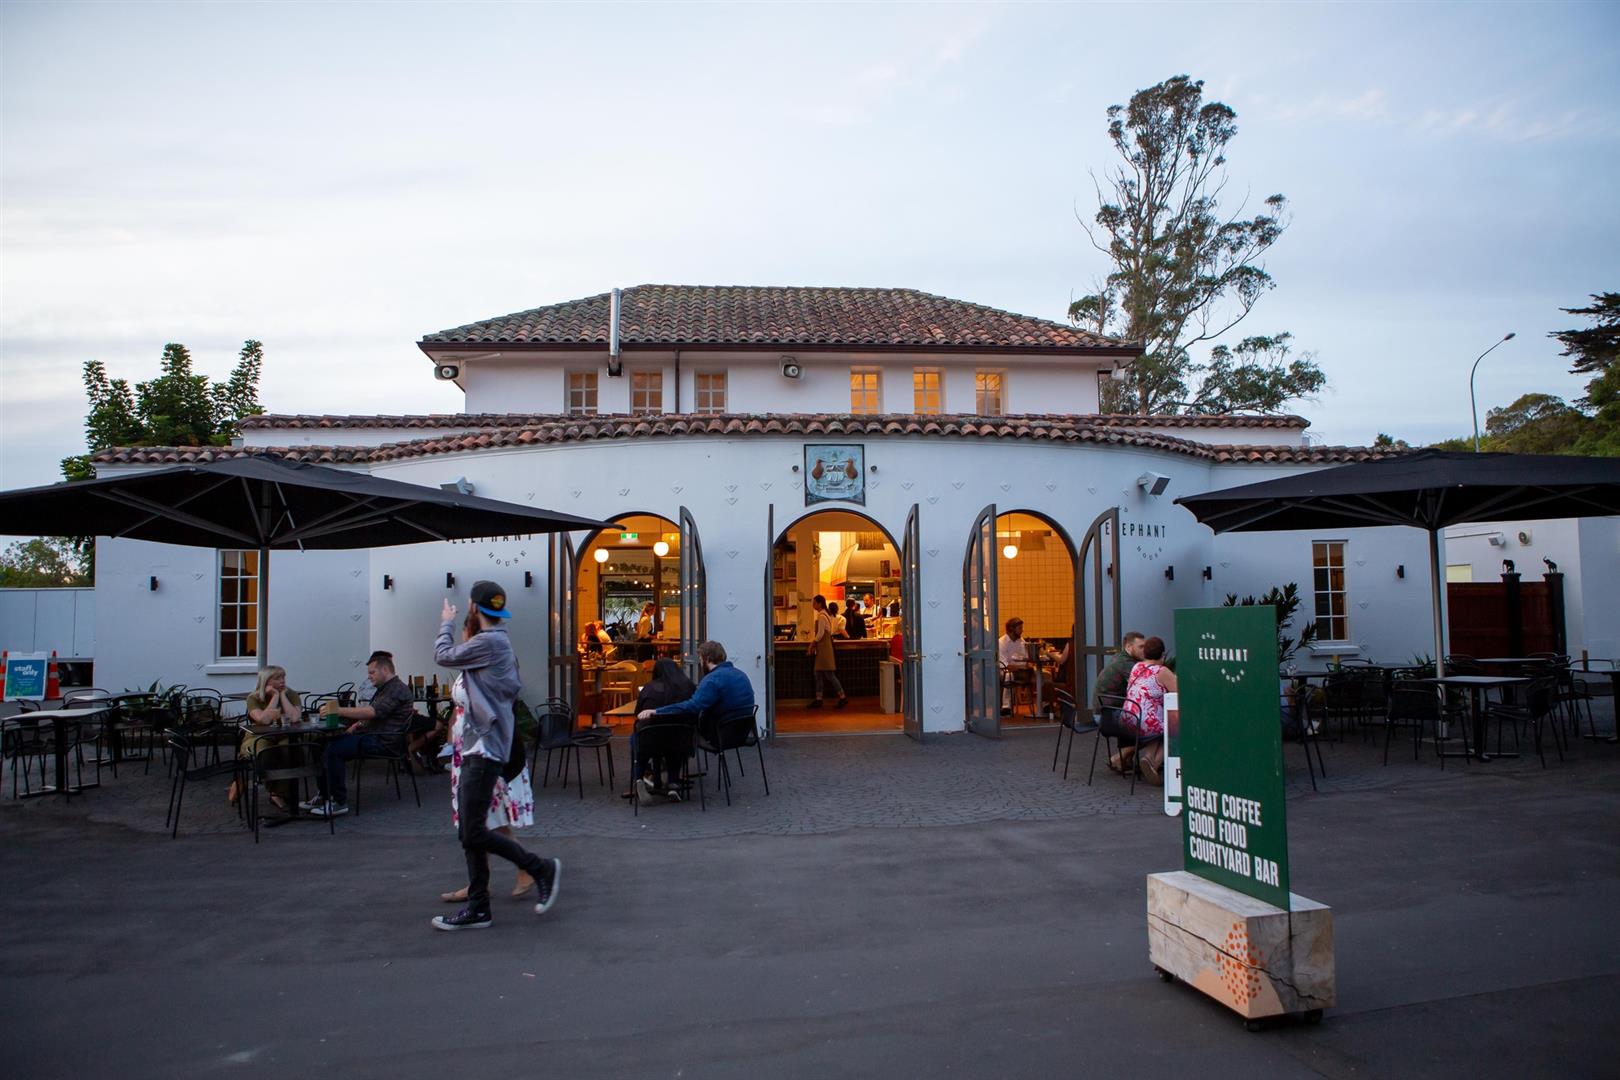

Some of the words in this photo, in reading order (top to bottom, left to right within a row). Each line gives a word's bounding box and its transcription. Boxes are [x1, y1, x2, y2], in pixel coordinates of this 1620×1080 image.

[1105, 522, 1166, 538] EEPHANT
[1199, 647, 1248, 662] ELEPHANT
[1187, 785, 1219, 815] GREAT
[1221, 794, 1262, 827] COFFEE
[1188, 810, 1216, 839] GOOD
[1218, 819, 1247, 849] FOOD
[1189, 835, 1251, 877] COURTYARD
[1254, 855, 1279, 887] BAR
